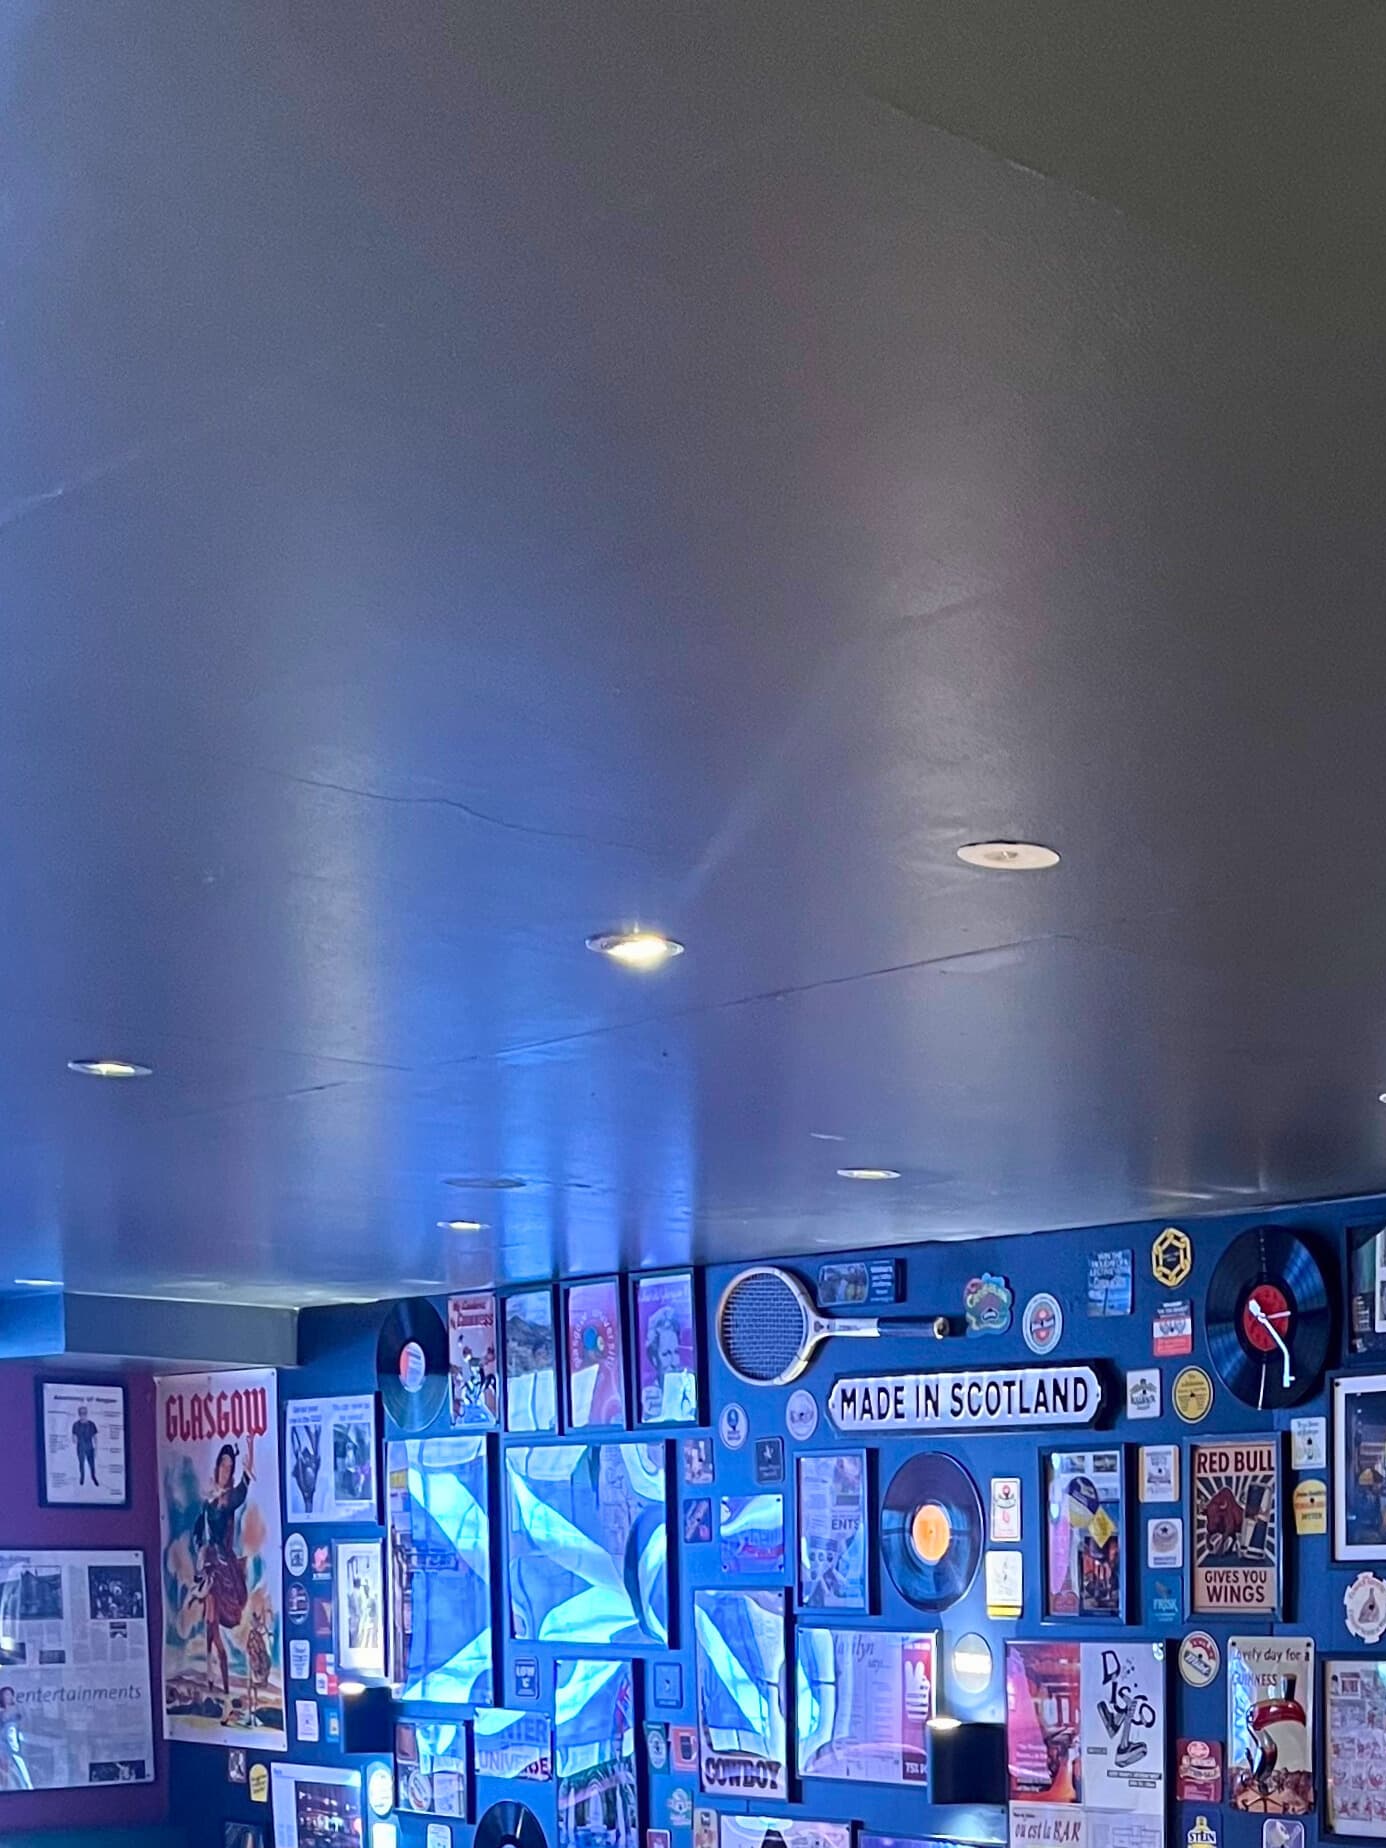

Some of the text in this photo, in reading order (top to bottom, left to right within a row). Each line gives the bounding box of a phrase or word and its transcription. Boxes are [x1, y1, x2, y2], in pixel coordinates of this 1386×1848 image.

[840, 1385, 905, 1422] MADE
[915, 1385, 940, 1420] IN
[949, 1374, 1088, 1419] SCOTLAND
[166, 1387, 268, 1442] GLASGOW
[1197, 1449, 1275, 1474] RED BULL
[1204, 1570, 1267, 1584] GIVES YOU
[1206, 1585, 1265, 1603] WINGS
[1264, 1648, 1283, 1664] day
[1286, 1647, 1301, 1661] for
[15, 1684, 142, 1704] entertainments
[1188, 1832, 1215, 1842] STEIN
